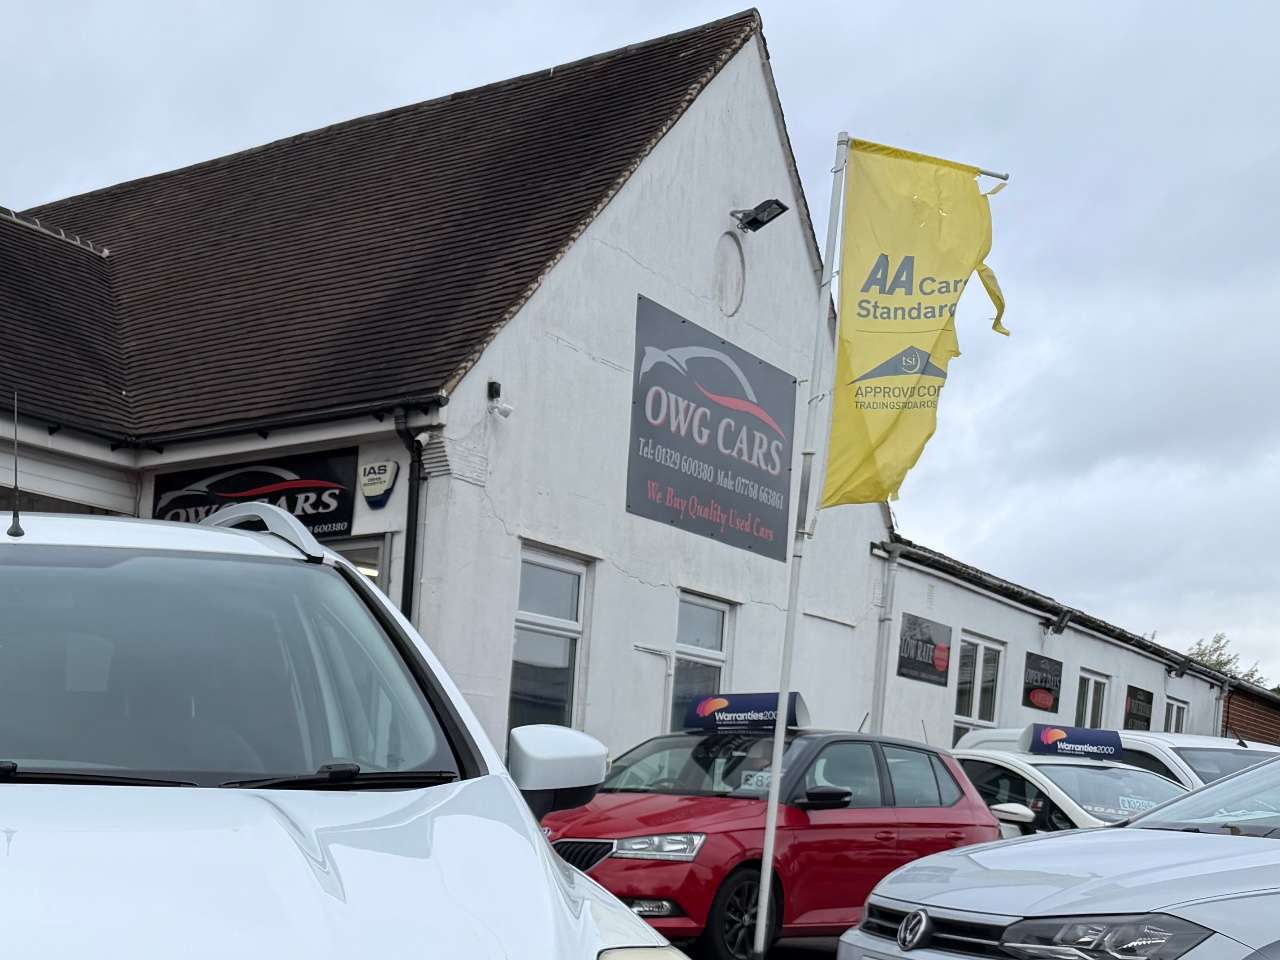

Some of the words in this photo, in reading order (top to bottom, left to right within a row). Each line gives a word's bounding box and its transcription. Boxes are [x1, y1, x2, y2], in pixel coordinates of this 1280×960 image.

[861, 253, 914, 295] AA
[645, 385, 711, 446] OWG
[717, 417, 784, 476] CARS
[363, 465, 387, 477] IAS
[639, 437, 653, 459] Tel:
[655, 445, 680, 470] 01329
[681, 455, 714, 482] 600380
[648, 479, 662, 503] We
[665, 487, 687, 520] Buy
[688, 495, 728, 533] Quality
[729, 508, 751, 532] Used
[753, 517, 774, 540] Cars
[313, 521, 348, 534] 600380
[715, 710, 778, 721] Warranties200
[1057, 741, 1115, 754] Warranties2000
